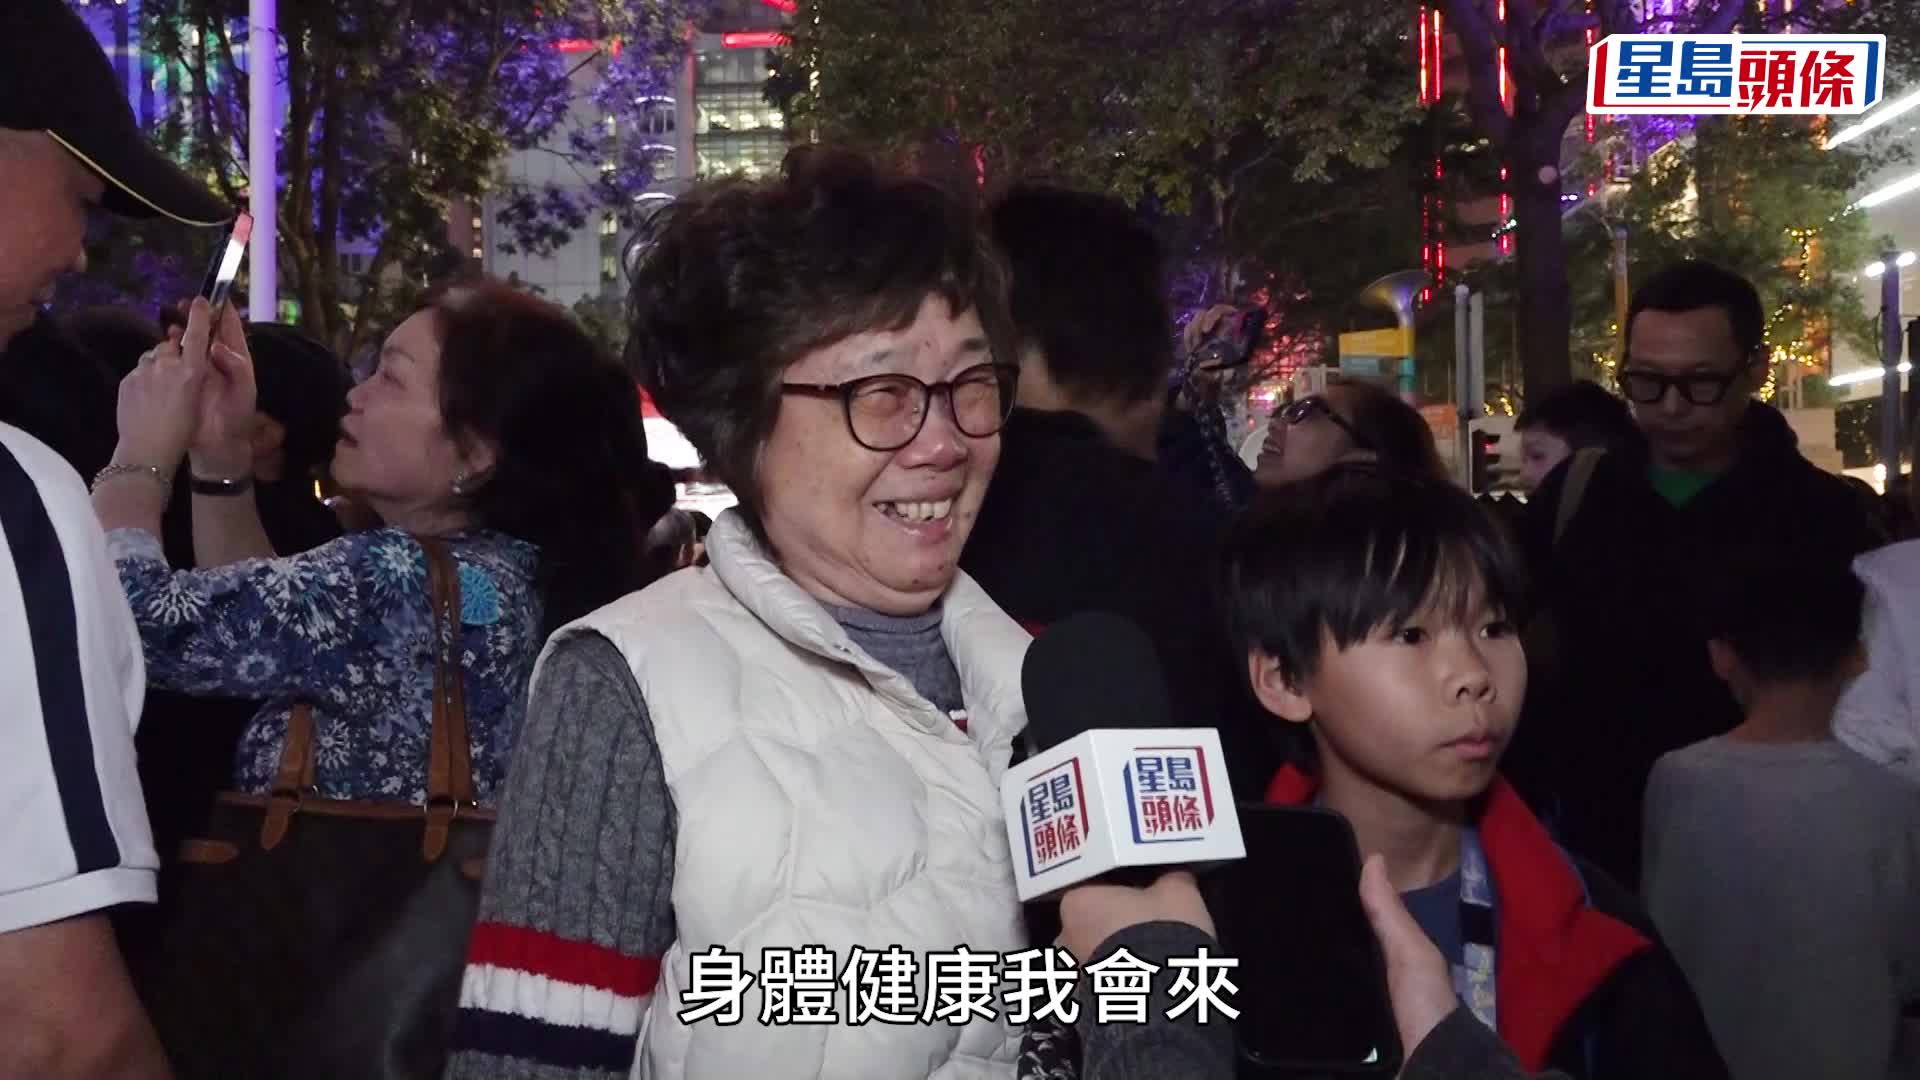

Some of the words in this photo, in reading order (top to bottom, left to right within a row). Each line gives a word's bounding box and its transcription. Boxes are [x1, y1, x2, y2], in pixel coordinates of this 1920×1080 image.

[1134, 756, 1196, 793] 星島
[1028, 773, 1074, 824] 星島
[1141, 795, 1203, 837] 頭條
[1033, 814, 1080, 865] 頭條
